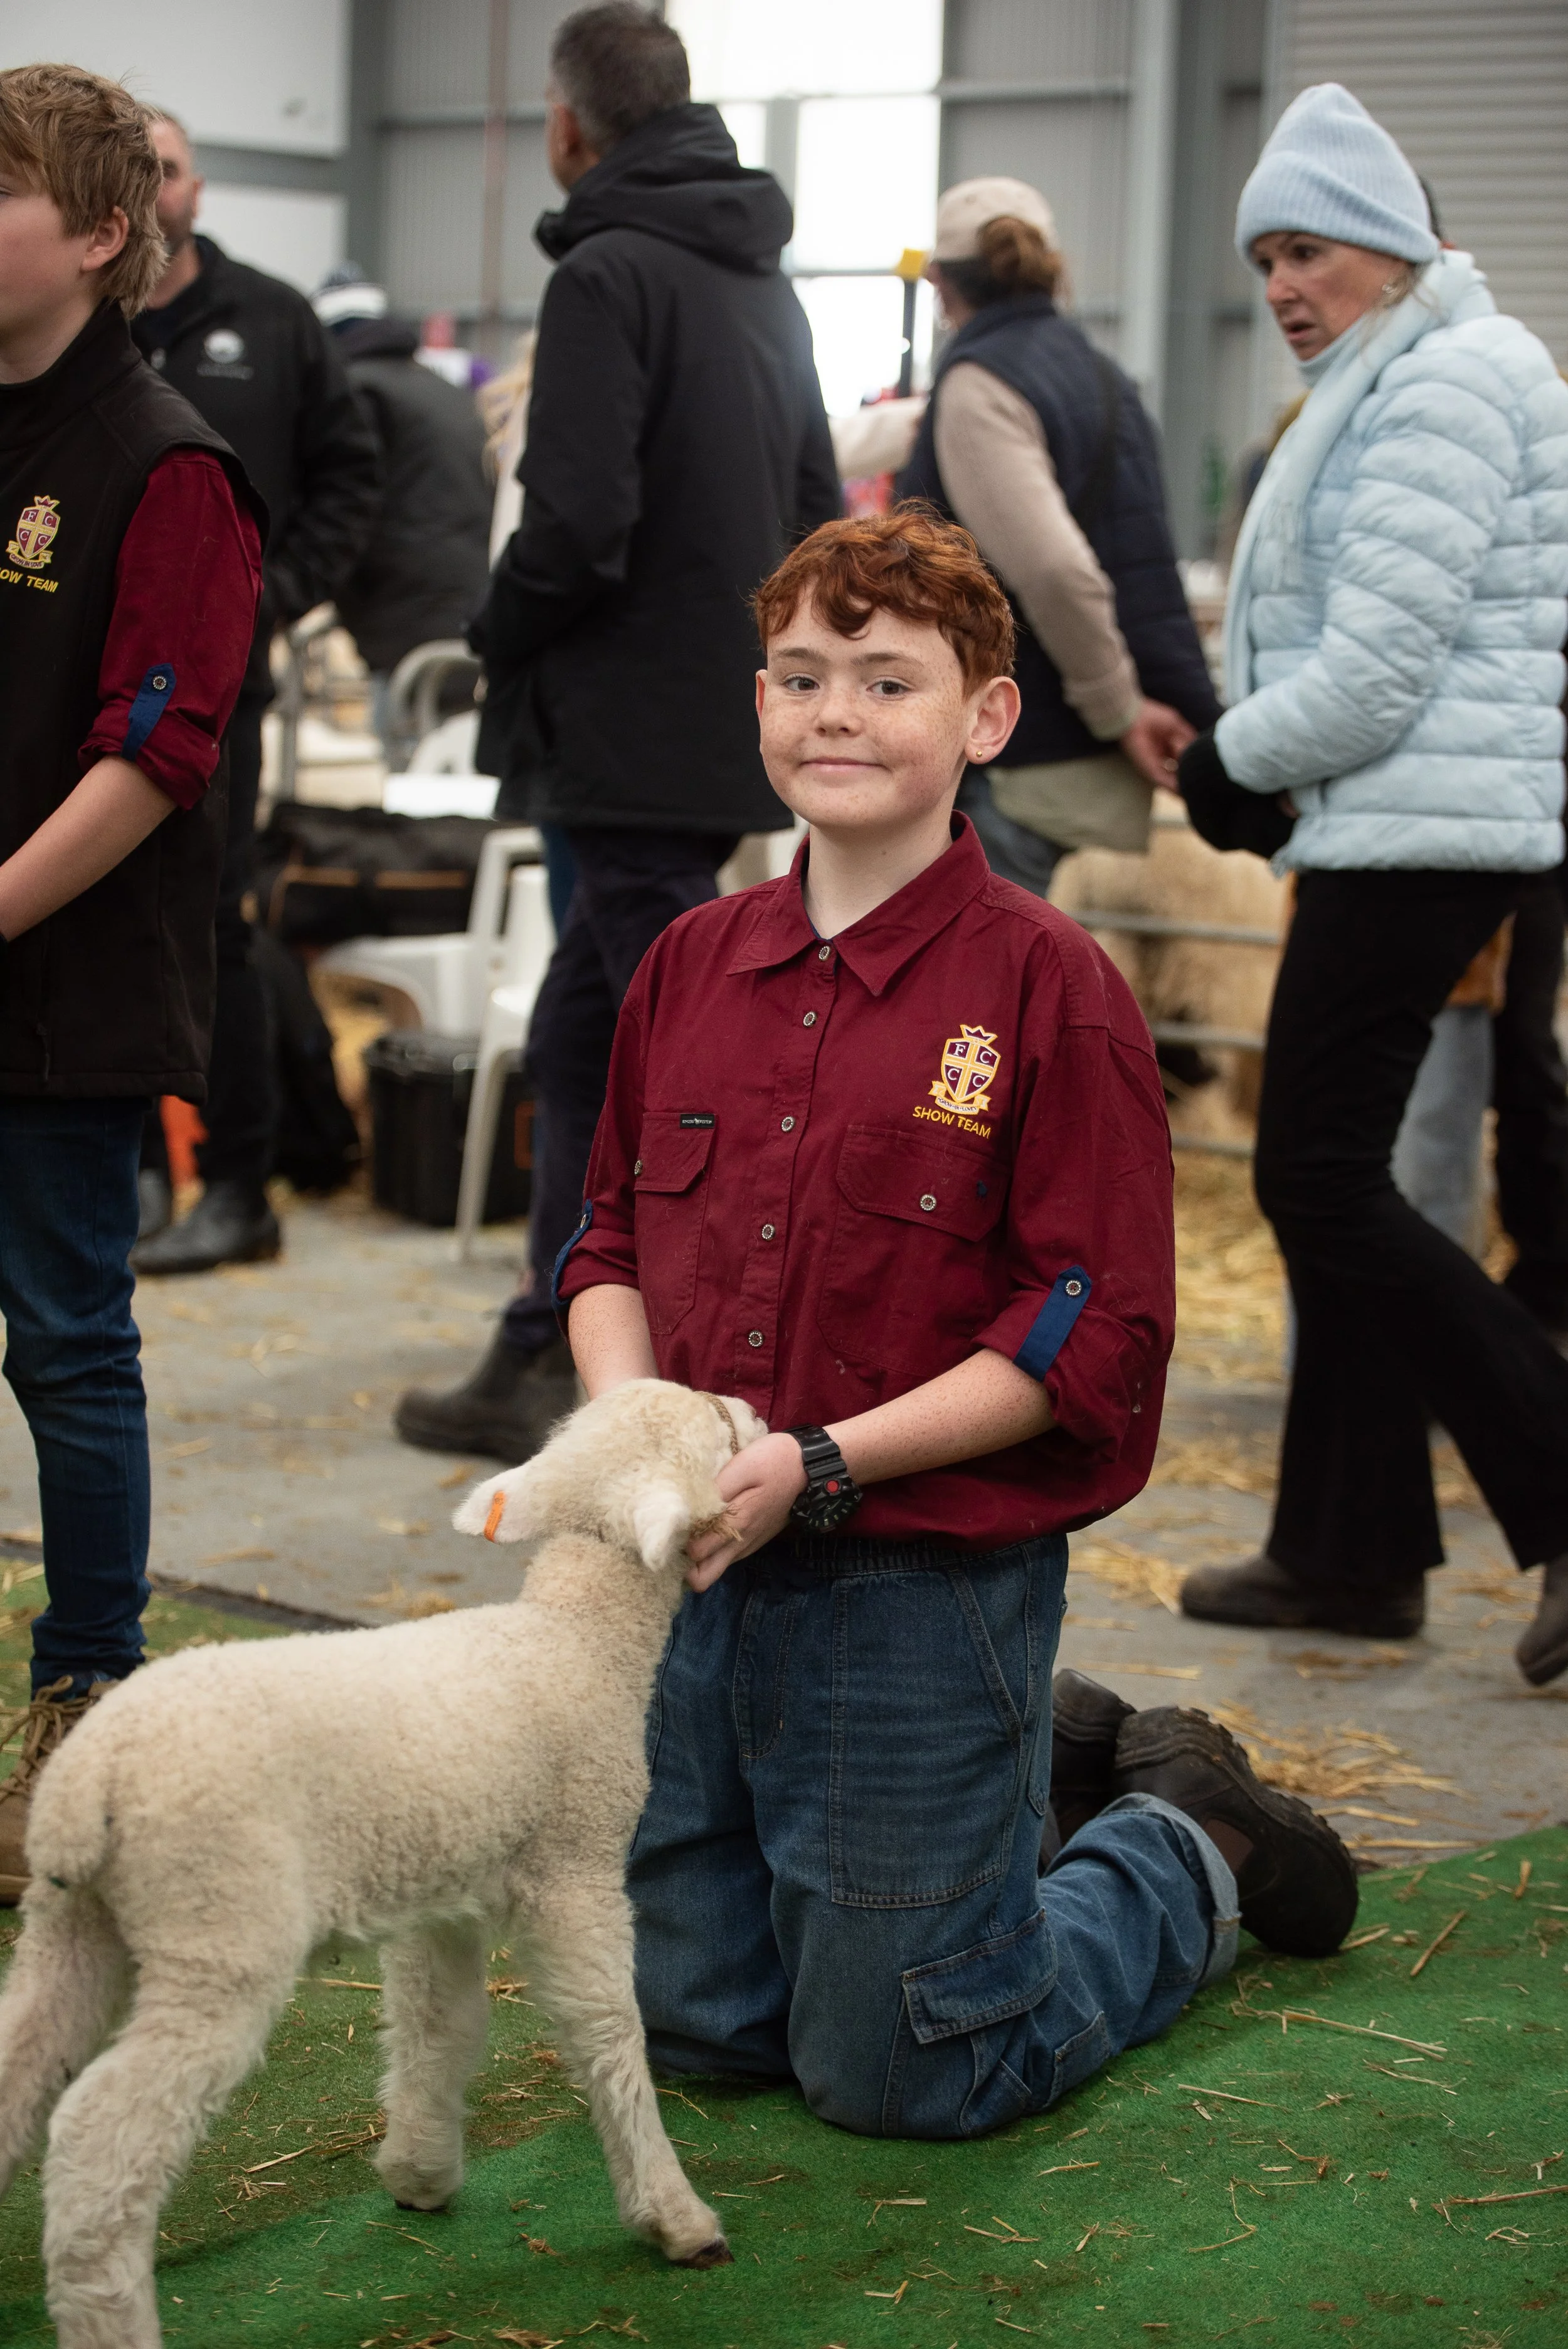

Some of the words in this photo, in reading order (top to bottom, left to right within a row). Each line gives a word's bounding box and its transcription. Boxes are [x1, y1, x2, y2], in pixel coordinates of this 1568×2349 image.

[26, 511, 36, 522] F
[45, 515, 54, 526] C
[19, 530, 29, 541] C
[38, 535, 48, 546] C
[0, 567, 24, 584] OW
[27, 575, 59, 593] TEAM
[953, 1043, 966, 1056] F
[980, 1051, 992, 1063] C
[947, 1068, 960, 1081] C
[972, 1075, 985, 1088] C
[913, 1106, 955, 1125] SHOW
[957, 1116, 991, 1139] TEAM
